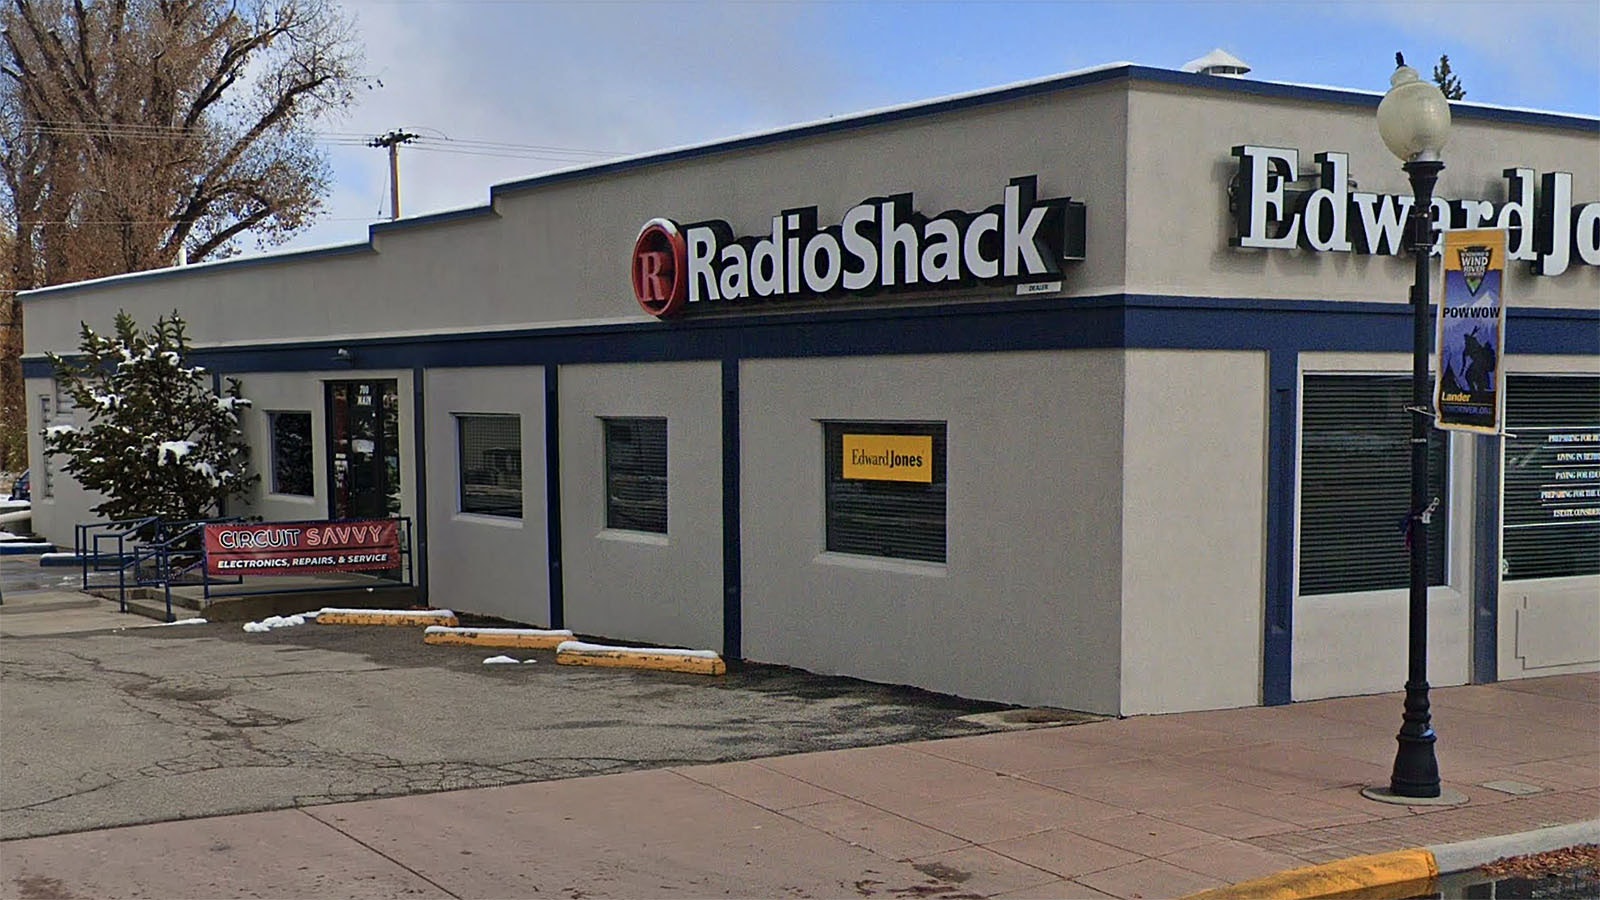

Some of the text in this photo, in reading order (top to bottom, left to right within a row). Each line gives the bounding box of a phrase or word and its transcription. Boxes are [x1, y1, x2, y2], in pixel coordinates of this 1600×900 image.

[686, 185, 1050, 302] RadioShack
[1461, 256, 1489, 266] WIND
[1441, 391, 1472, 402] Lander
[218, 525, 383, 549] CIRCUIT SAVVY
[218, 553, 388, 569] ELECTRONICS, REPAIRS, & SERVICE
